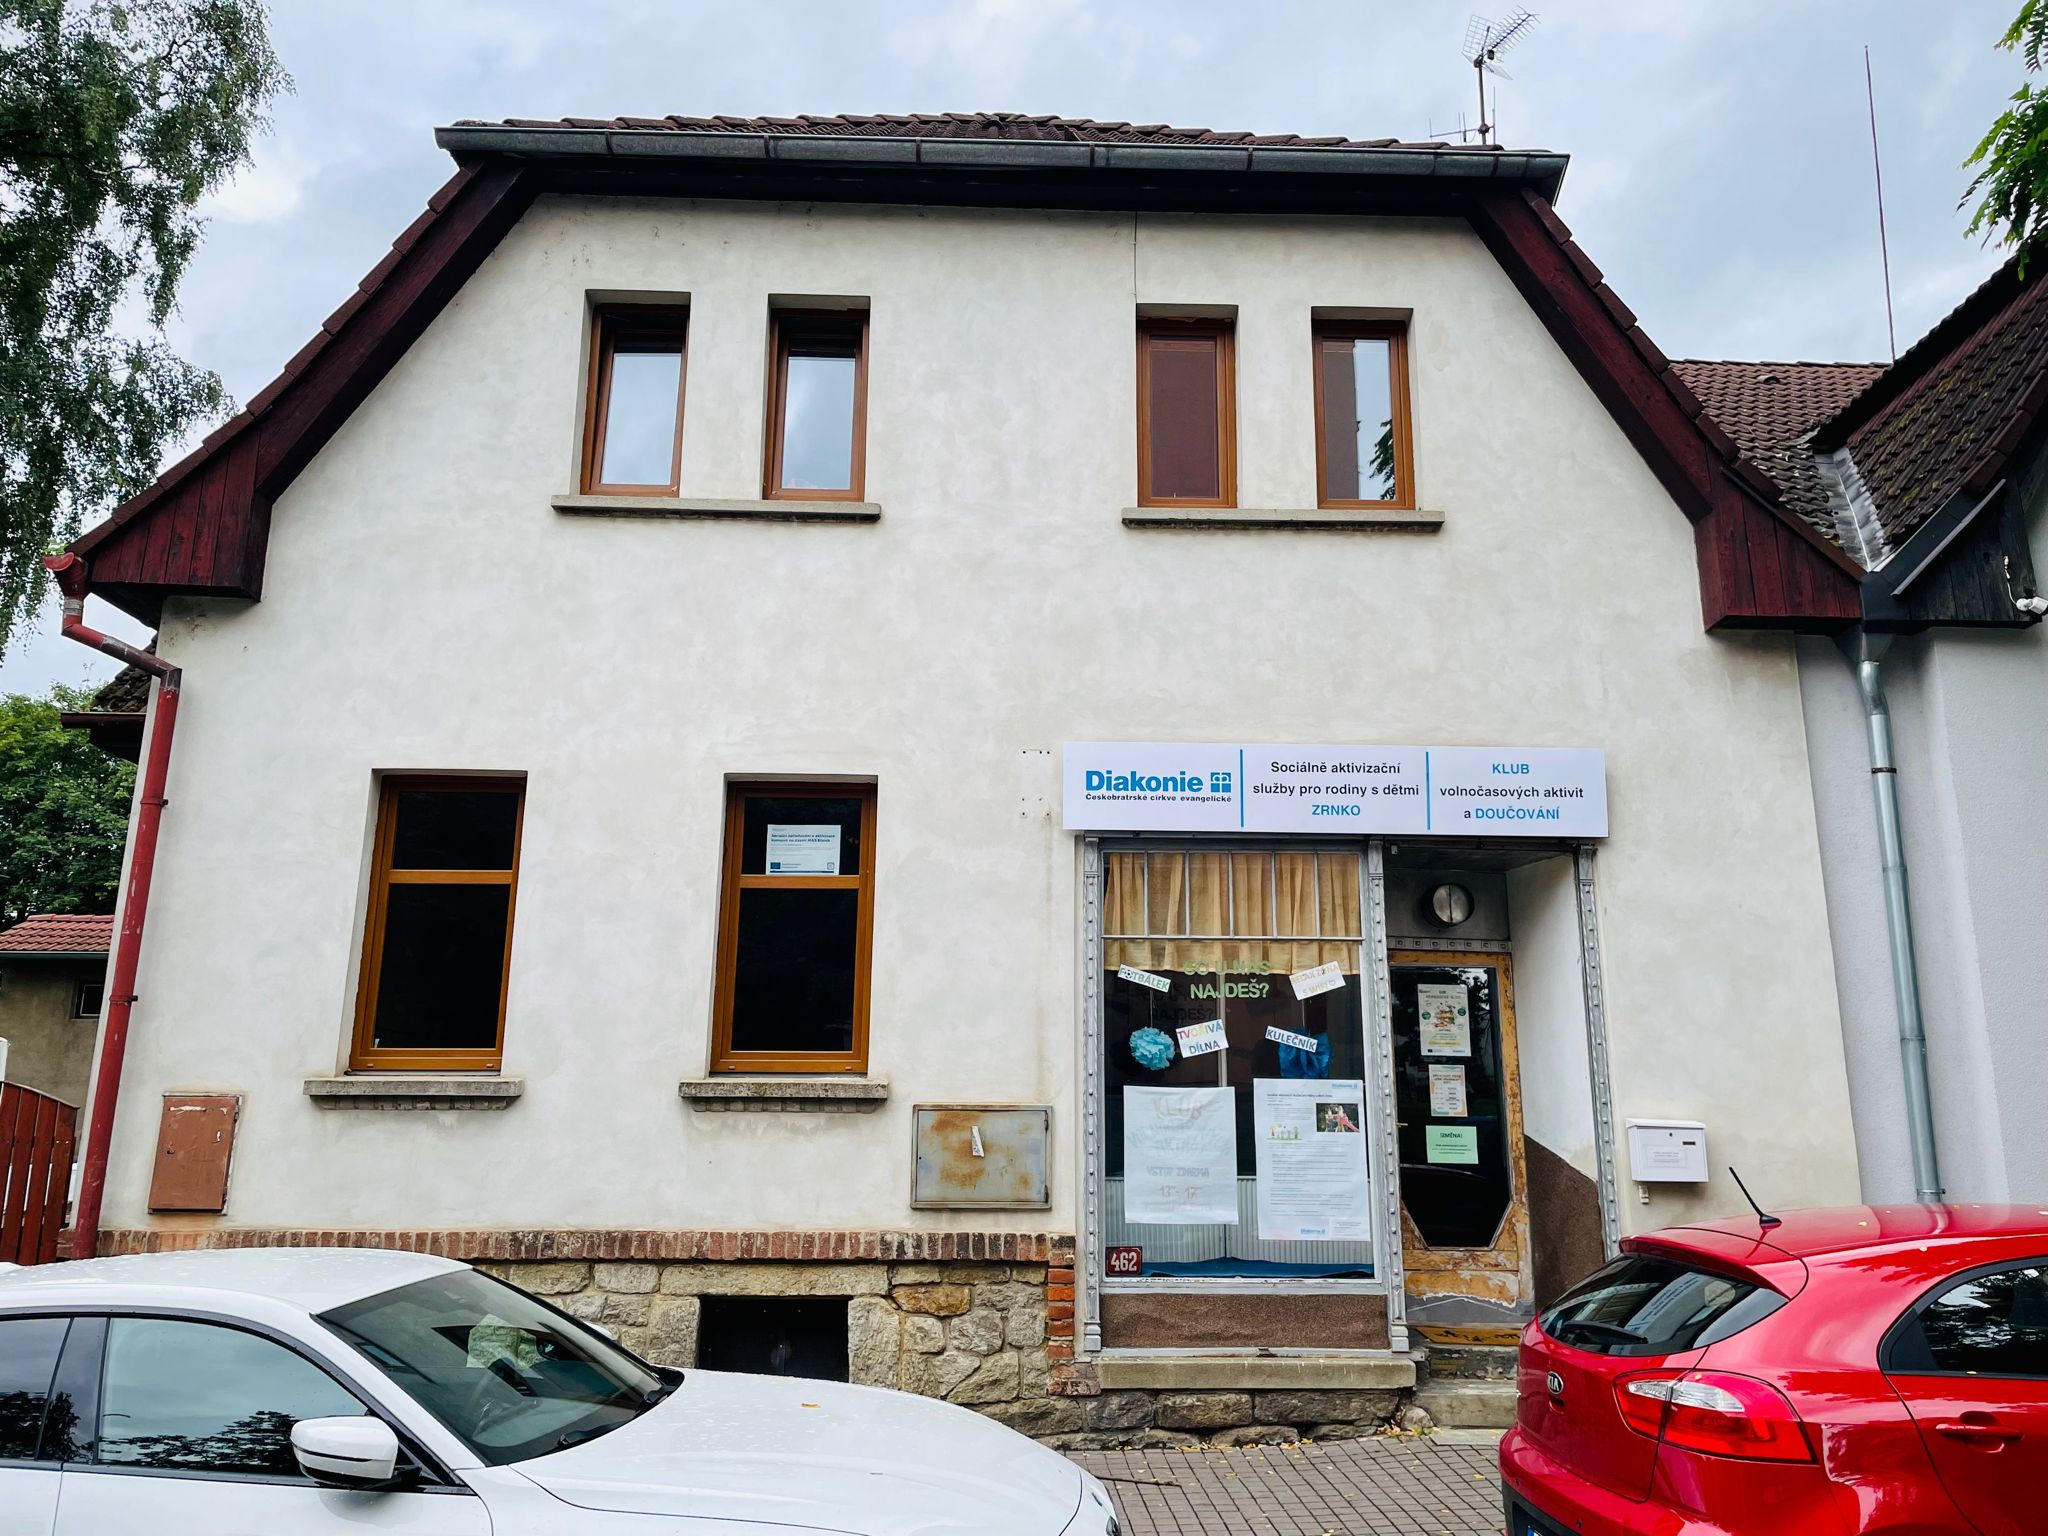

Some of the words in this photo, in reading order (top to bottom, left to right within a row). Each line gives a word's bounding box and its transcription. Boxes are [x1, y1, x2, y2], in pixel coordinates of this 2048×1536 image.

[1271, 761, 1327, 773] Sociálně
[1331, 762, 1401, 774] aktivizační
[1492, 763, 1530, 775] KLUB
[1086, 770, 1203, 792] Diakonie
[1086, 791, 1148, 801] Českobratrské
[1150, 793, 1176, 802] církve
[1180, 795, 1231, 803] evangelické
[1253, 783, 1295, 797] služby
[1300, 786, 1321, 797] pro
[1325, 784, 1367, 797] rodiny
[1371, 787, 1379, 795] s
[1383, 784, 1419, 796] dětmi
[1440, 786, 1539, 799] volnočasových
[1544, 787, 1584, 798] aktivit
[1311, 804, 1361, 816] ZRNKO
[1464, 810, 1471, 819] a
[1475, 806, 1560, 820] DOUČOVÁNÍ
[1190, 978, 1269, 999] NAJDEŠ?
[1189, 1039, 1221, 1055] DÍLNA
[1266, 1029, 1316, 1052] KULEČNÍK
[1110, 1251, 1138, 1272] 462
